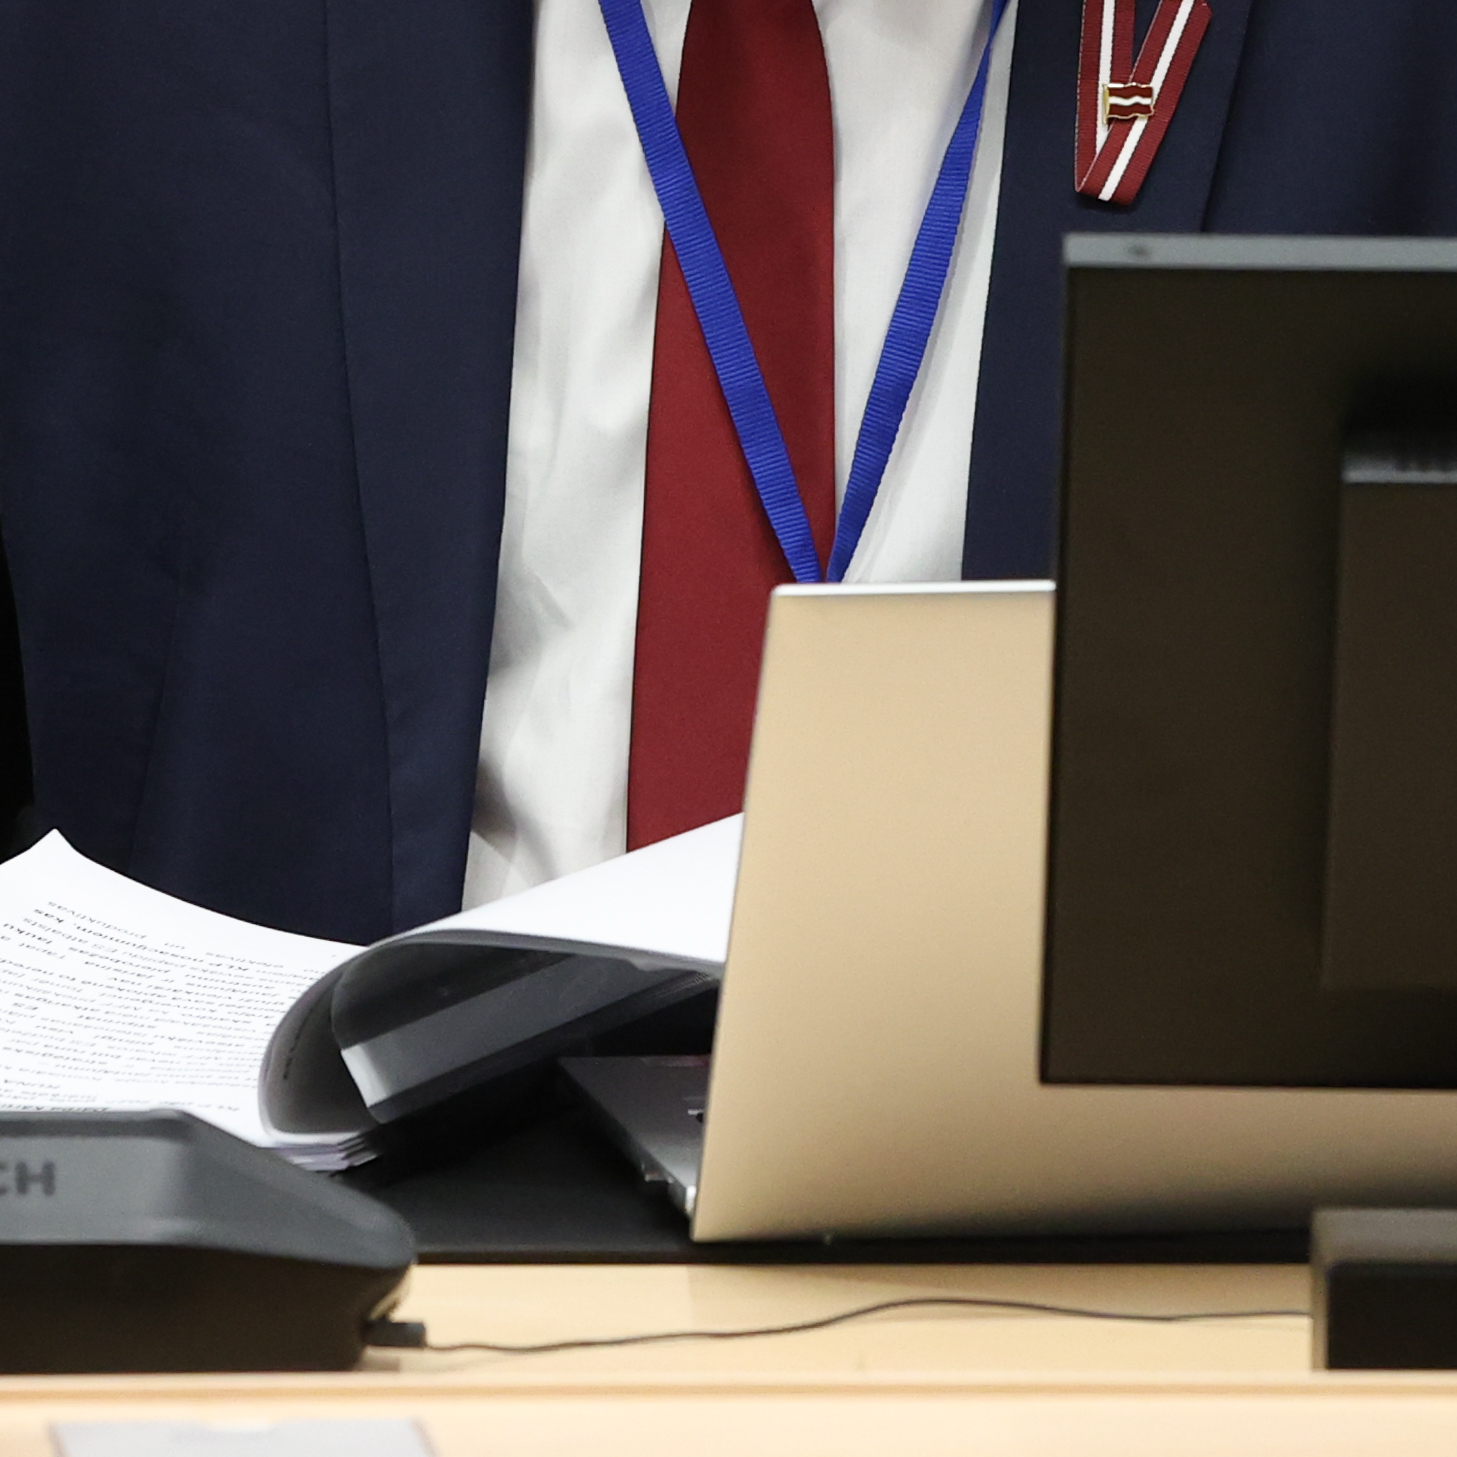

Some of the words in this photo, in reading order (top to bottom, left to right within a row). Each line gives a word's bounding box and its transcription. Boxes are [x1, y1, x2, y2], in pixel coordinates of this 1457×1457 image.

[33, 908, 65, 925] kas
[47, 901, 147, 940] produktīvas
[3, 922, 53, 945] lauku
[208, 962, 250, 972] KLP
